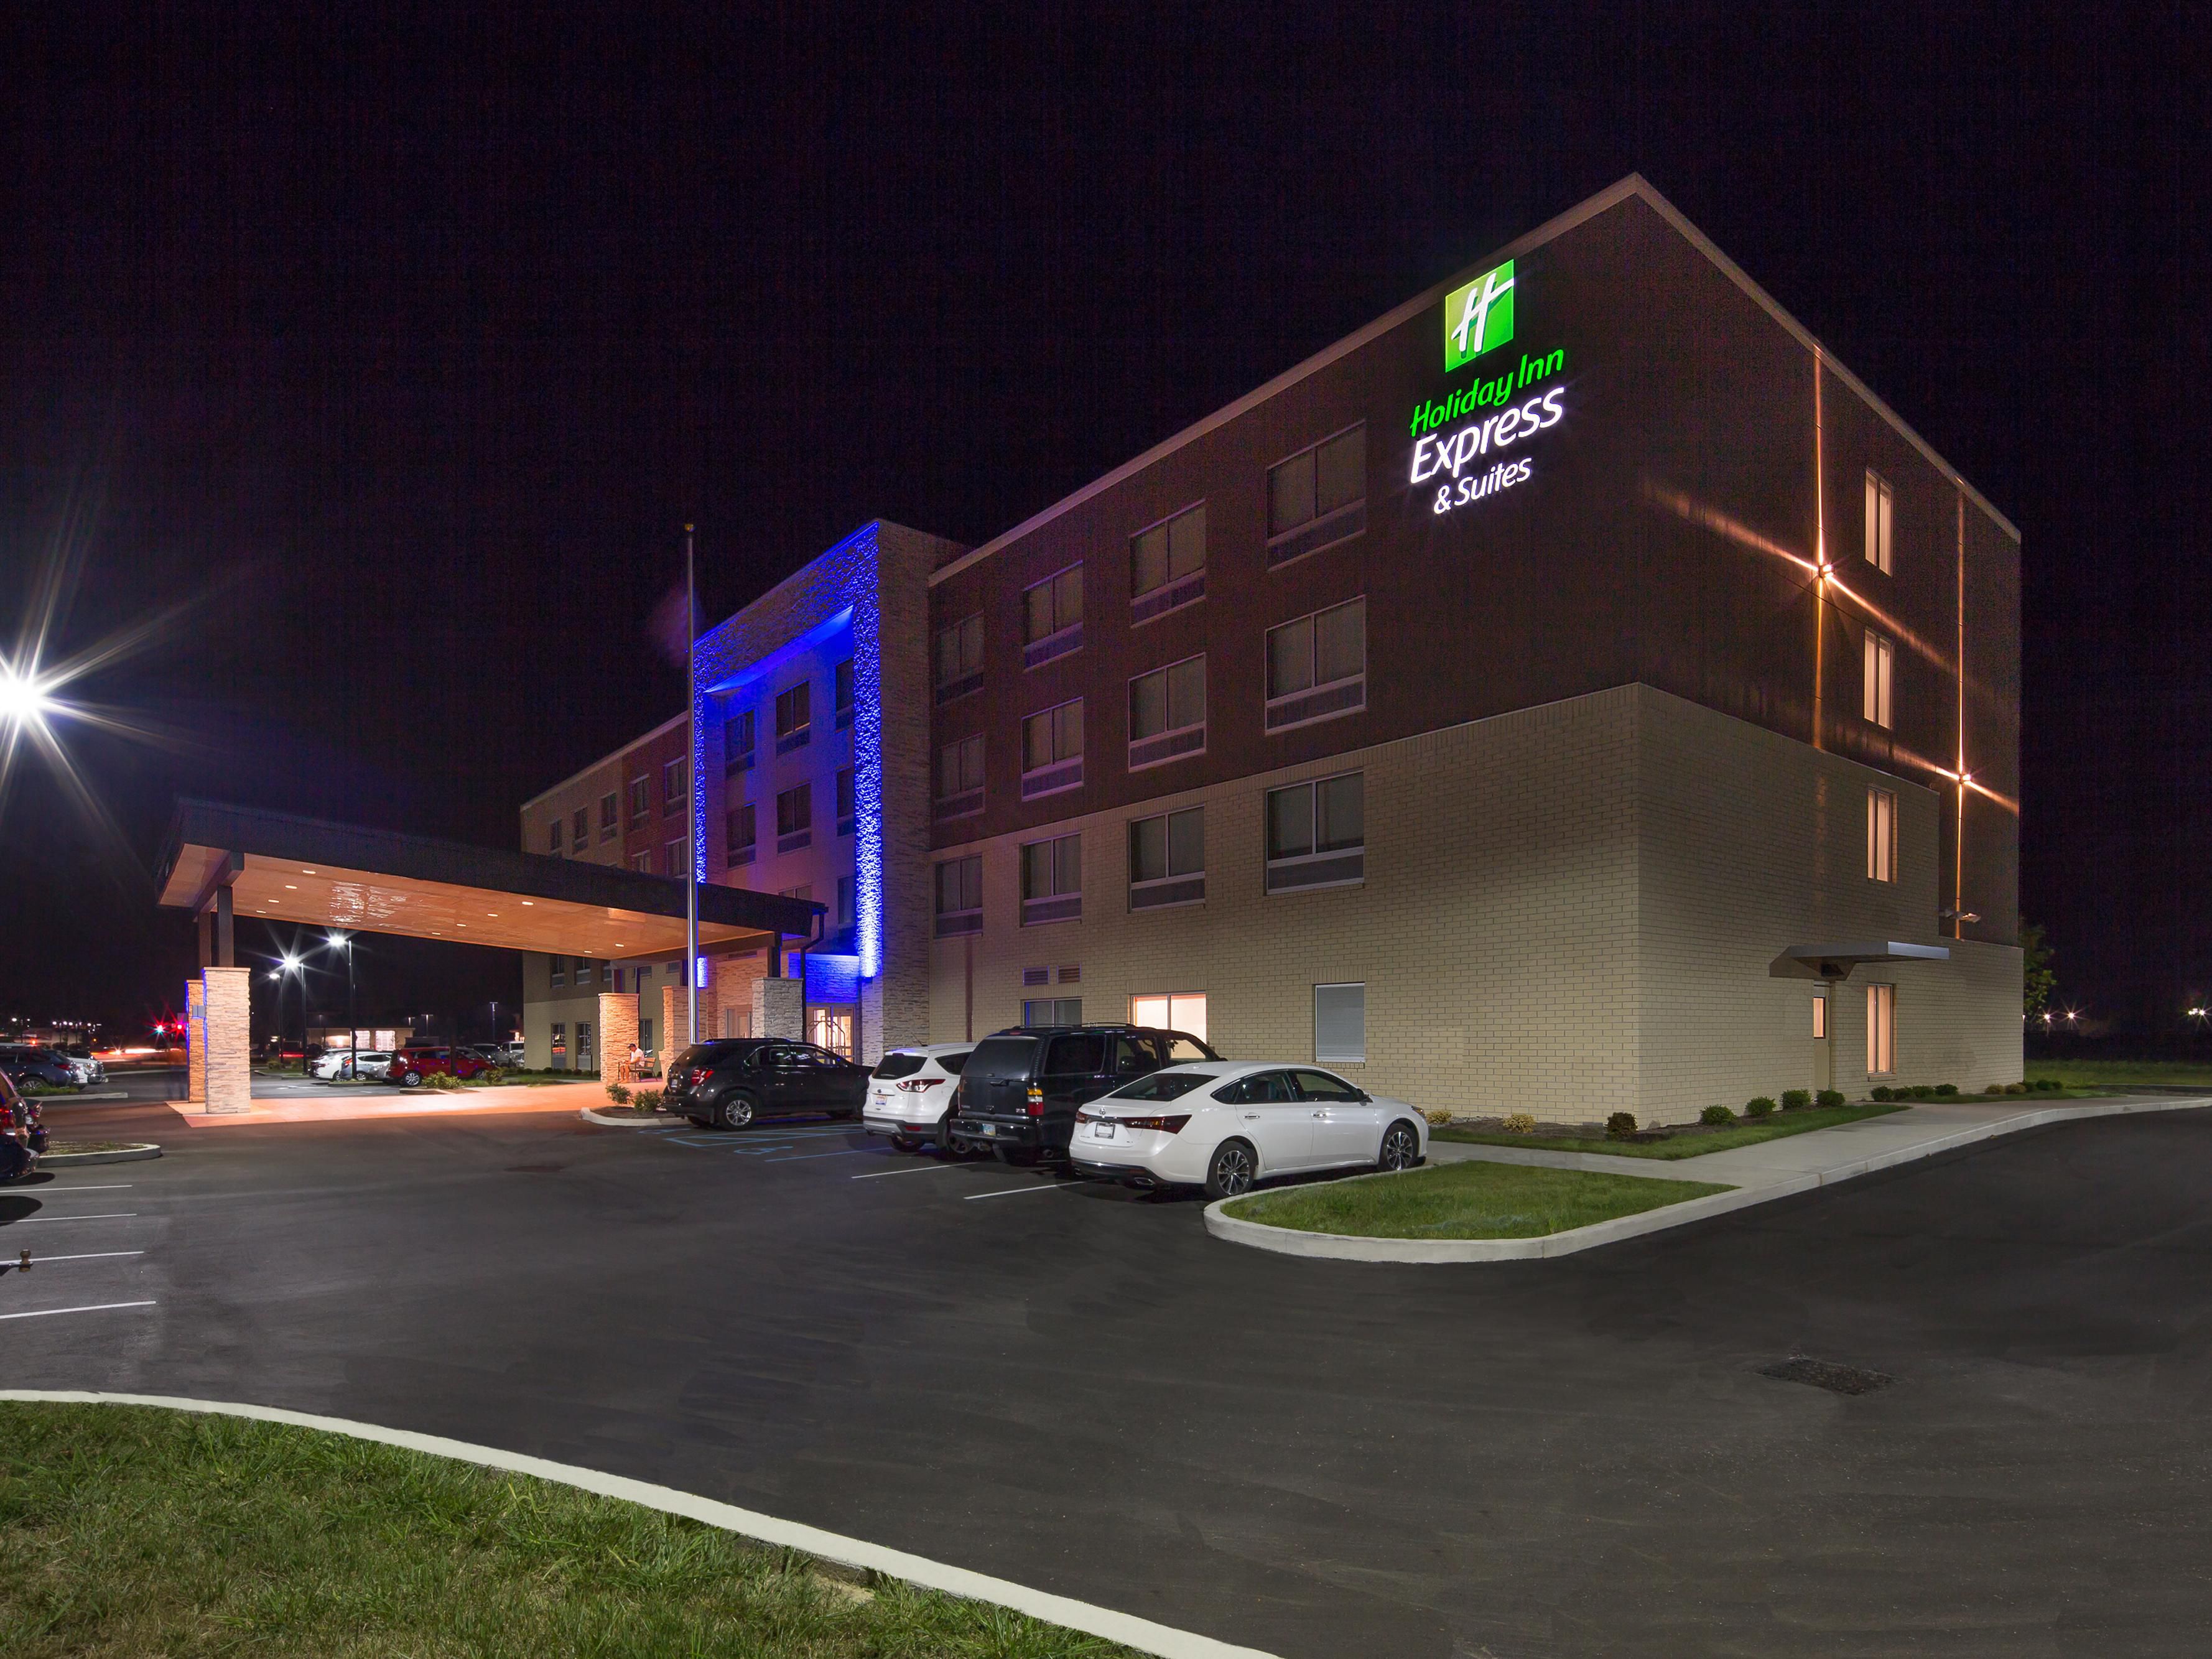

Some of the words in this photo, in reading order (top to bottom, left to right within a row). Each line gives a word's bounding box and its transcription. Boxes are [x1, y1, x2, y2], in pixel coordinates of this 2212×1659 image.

[1410, 372, 1513, 437] Holiday
[1518, 349, 1564, 389] Inn
[1410, 387, 1564, 484] Express
[1433, 485, 1452, 514] &
[1454, 457, 1532, 506] Suites
